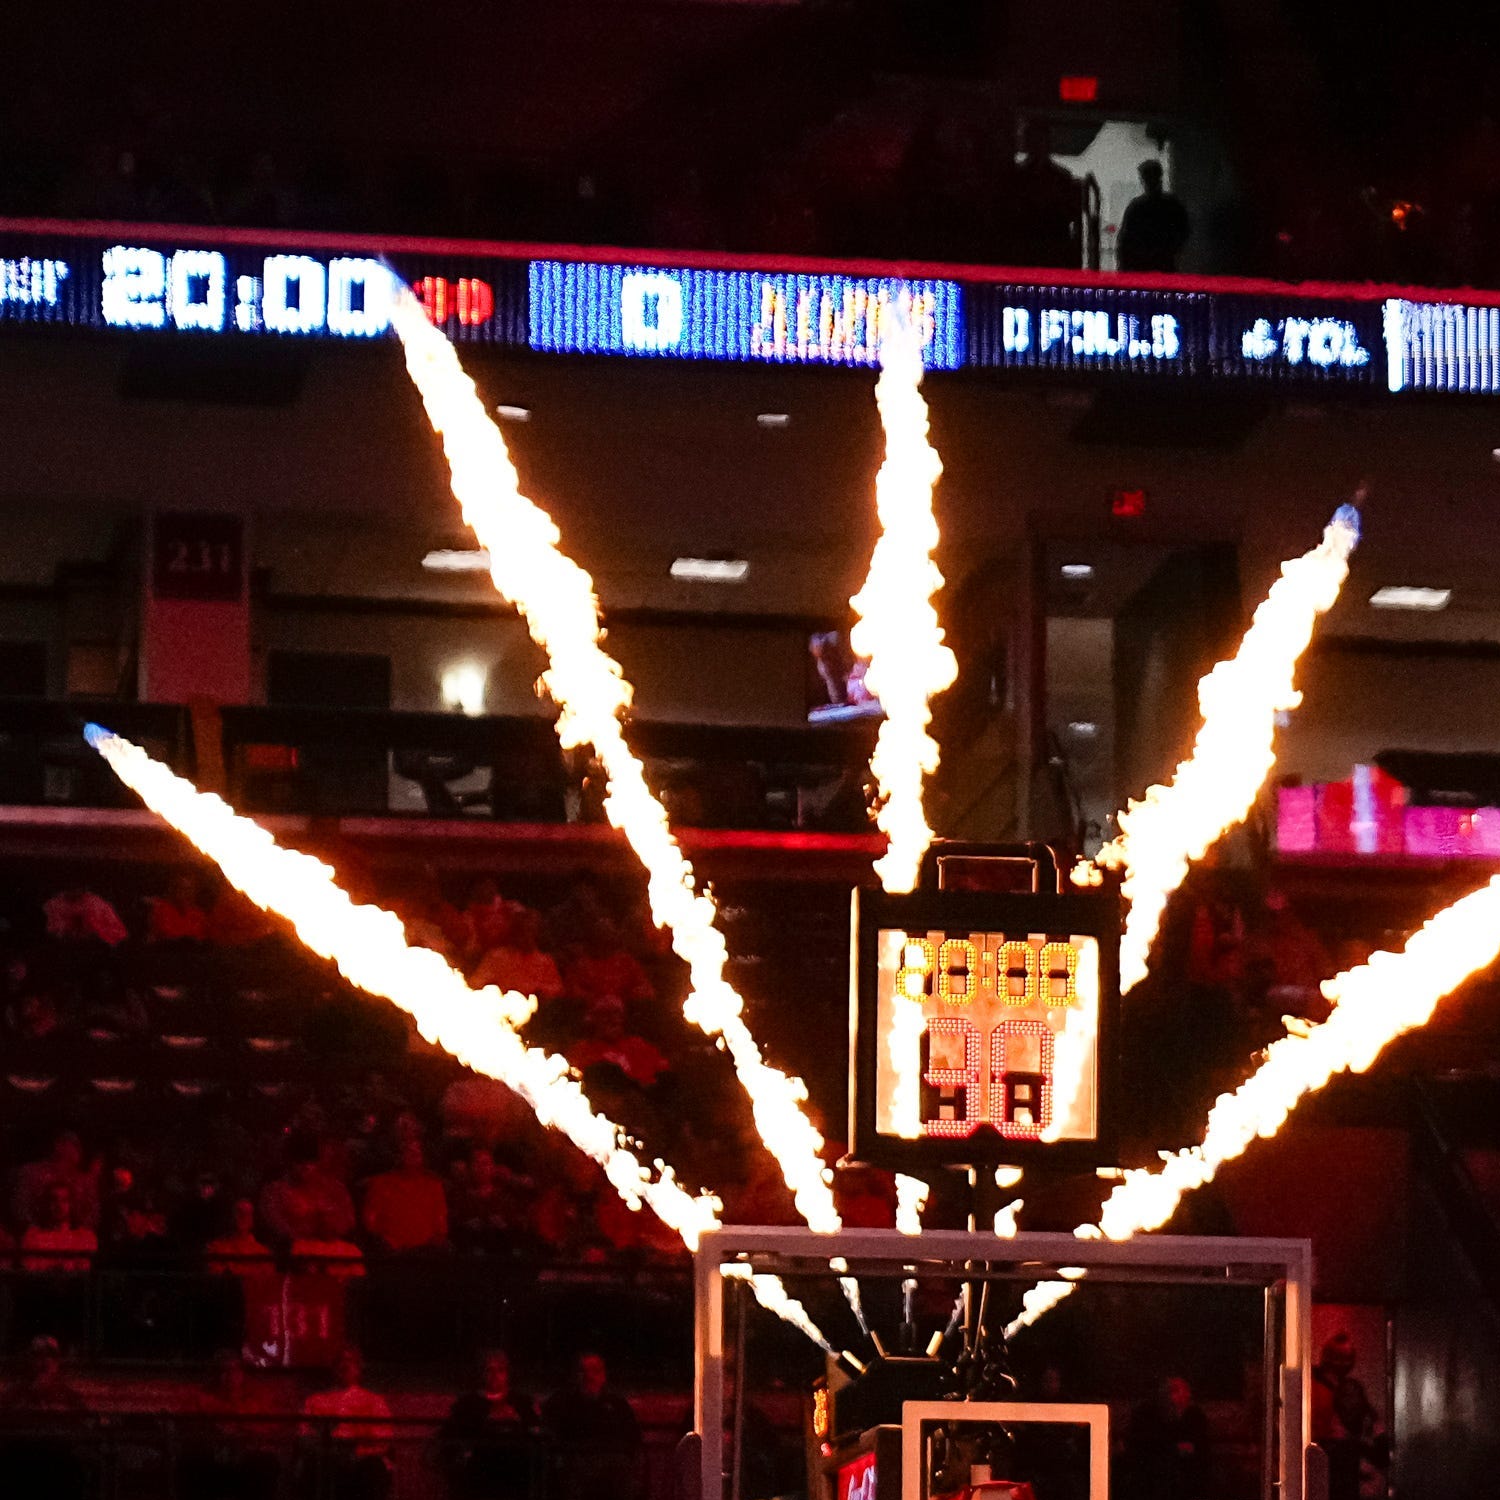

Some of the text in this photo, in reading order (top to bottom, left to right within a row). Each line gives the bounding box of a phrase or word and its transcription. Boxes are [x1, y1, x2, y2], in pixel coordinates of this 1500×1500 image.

[101, 245, 394, 337] 20:00
[621, 270, 682, 351] 0
[896, 937, 1077, 1009] 20:00
[921, 1017, 1055, 1140] 30
